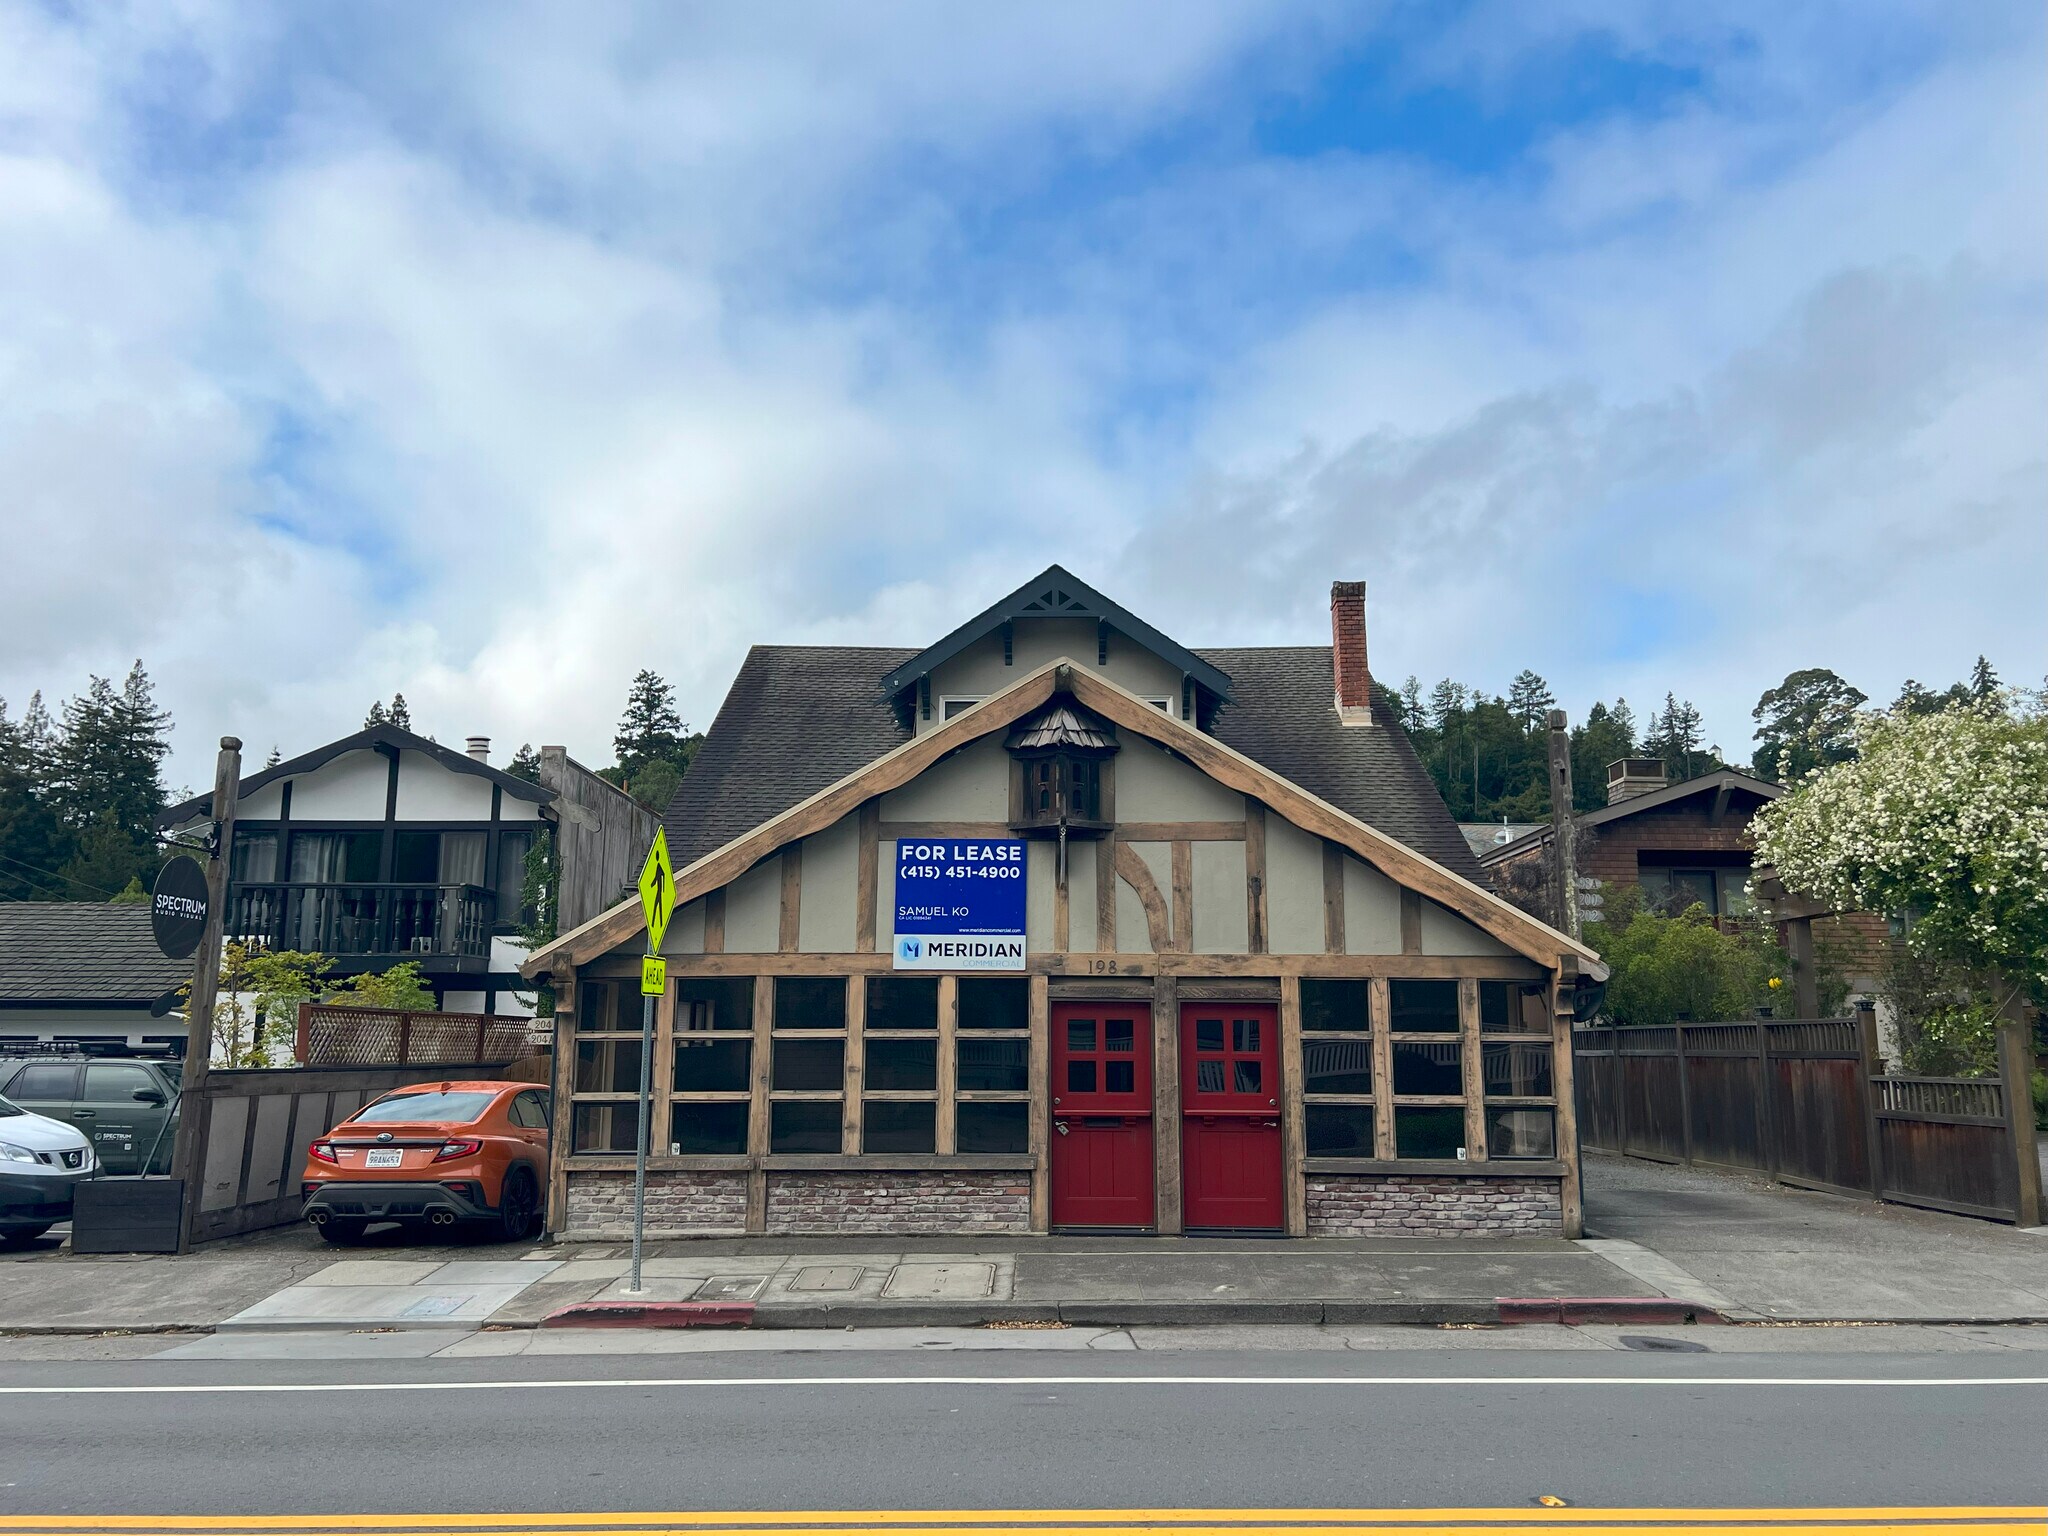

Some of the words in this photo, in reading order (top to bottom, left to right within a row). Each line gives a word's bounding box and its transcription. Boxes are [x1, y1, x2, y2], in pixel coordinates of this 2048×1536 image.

[901, 845, 946, 861] FOR
[953, 845, 1021, 861] LEASE
[900, 865, 940, 879] (415)
[945, 865, 1020, 879] 451-4900
[156, 893, 207, 915] SPECTRUM
[155, 908, 176, 917] AUDIO
[180, 913, 203, 921] VISUAL
[898, 906, 948, 917] SAMUEL
[952, 907, 969, 917] KO
[928, 942, 1022, 957] MERIDIAN
[962, 959, 1021, 968] COMMERCIAL
[1087, 959, 1117, 975] 198
[644, 967, 663, 986] AHEAD
[534, 1019, 552, 1029] 204
